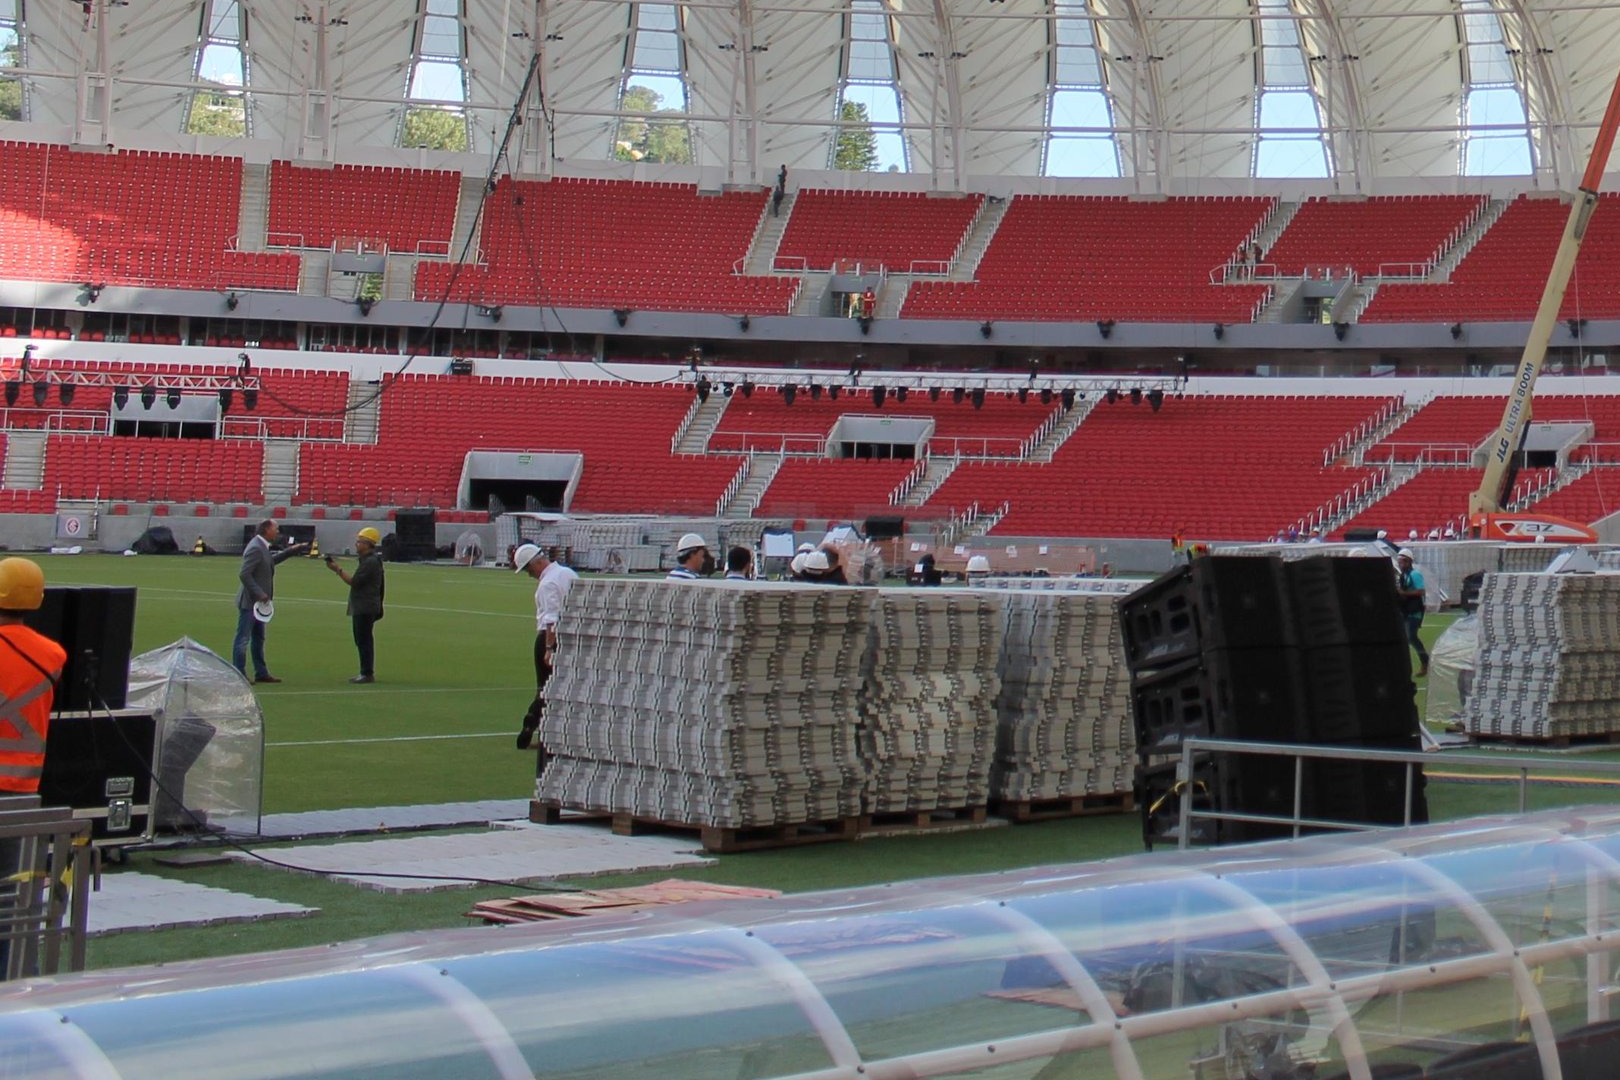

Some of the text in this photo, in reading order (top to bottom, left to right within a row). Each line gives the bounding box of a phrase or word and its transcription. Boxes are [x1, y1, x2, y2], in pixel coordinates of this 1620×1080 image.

[1496, 362, 1534, 463] JLG ULTRA BOOM
